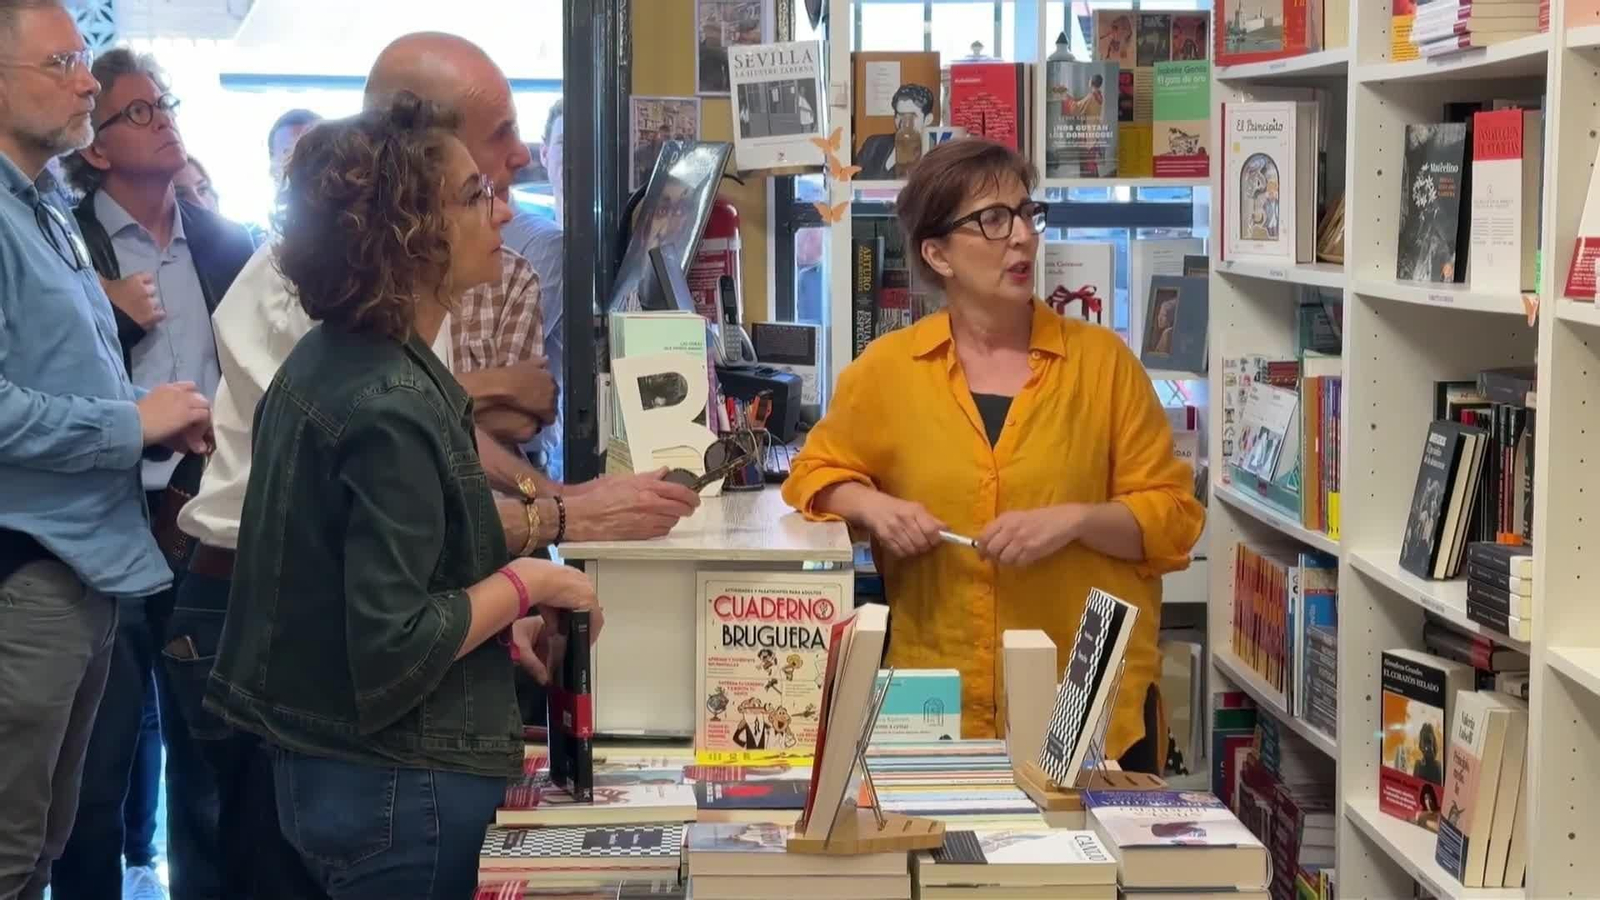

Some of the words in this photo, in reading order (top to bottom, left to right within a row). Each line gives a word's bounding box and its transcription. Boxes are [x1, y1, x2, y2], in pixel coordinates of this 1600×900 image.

[734, 49, 814, 68] SEVILLA
[1237, 119, 1245, 132] El
[1246, 117, 1283, 134] Principito
[863, 246, 872, 292] ARTURO
[713, 595, 835, 621] CUADERNO
[722, 625, 827, 650] BRUGUERA
